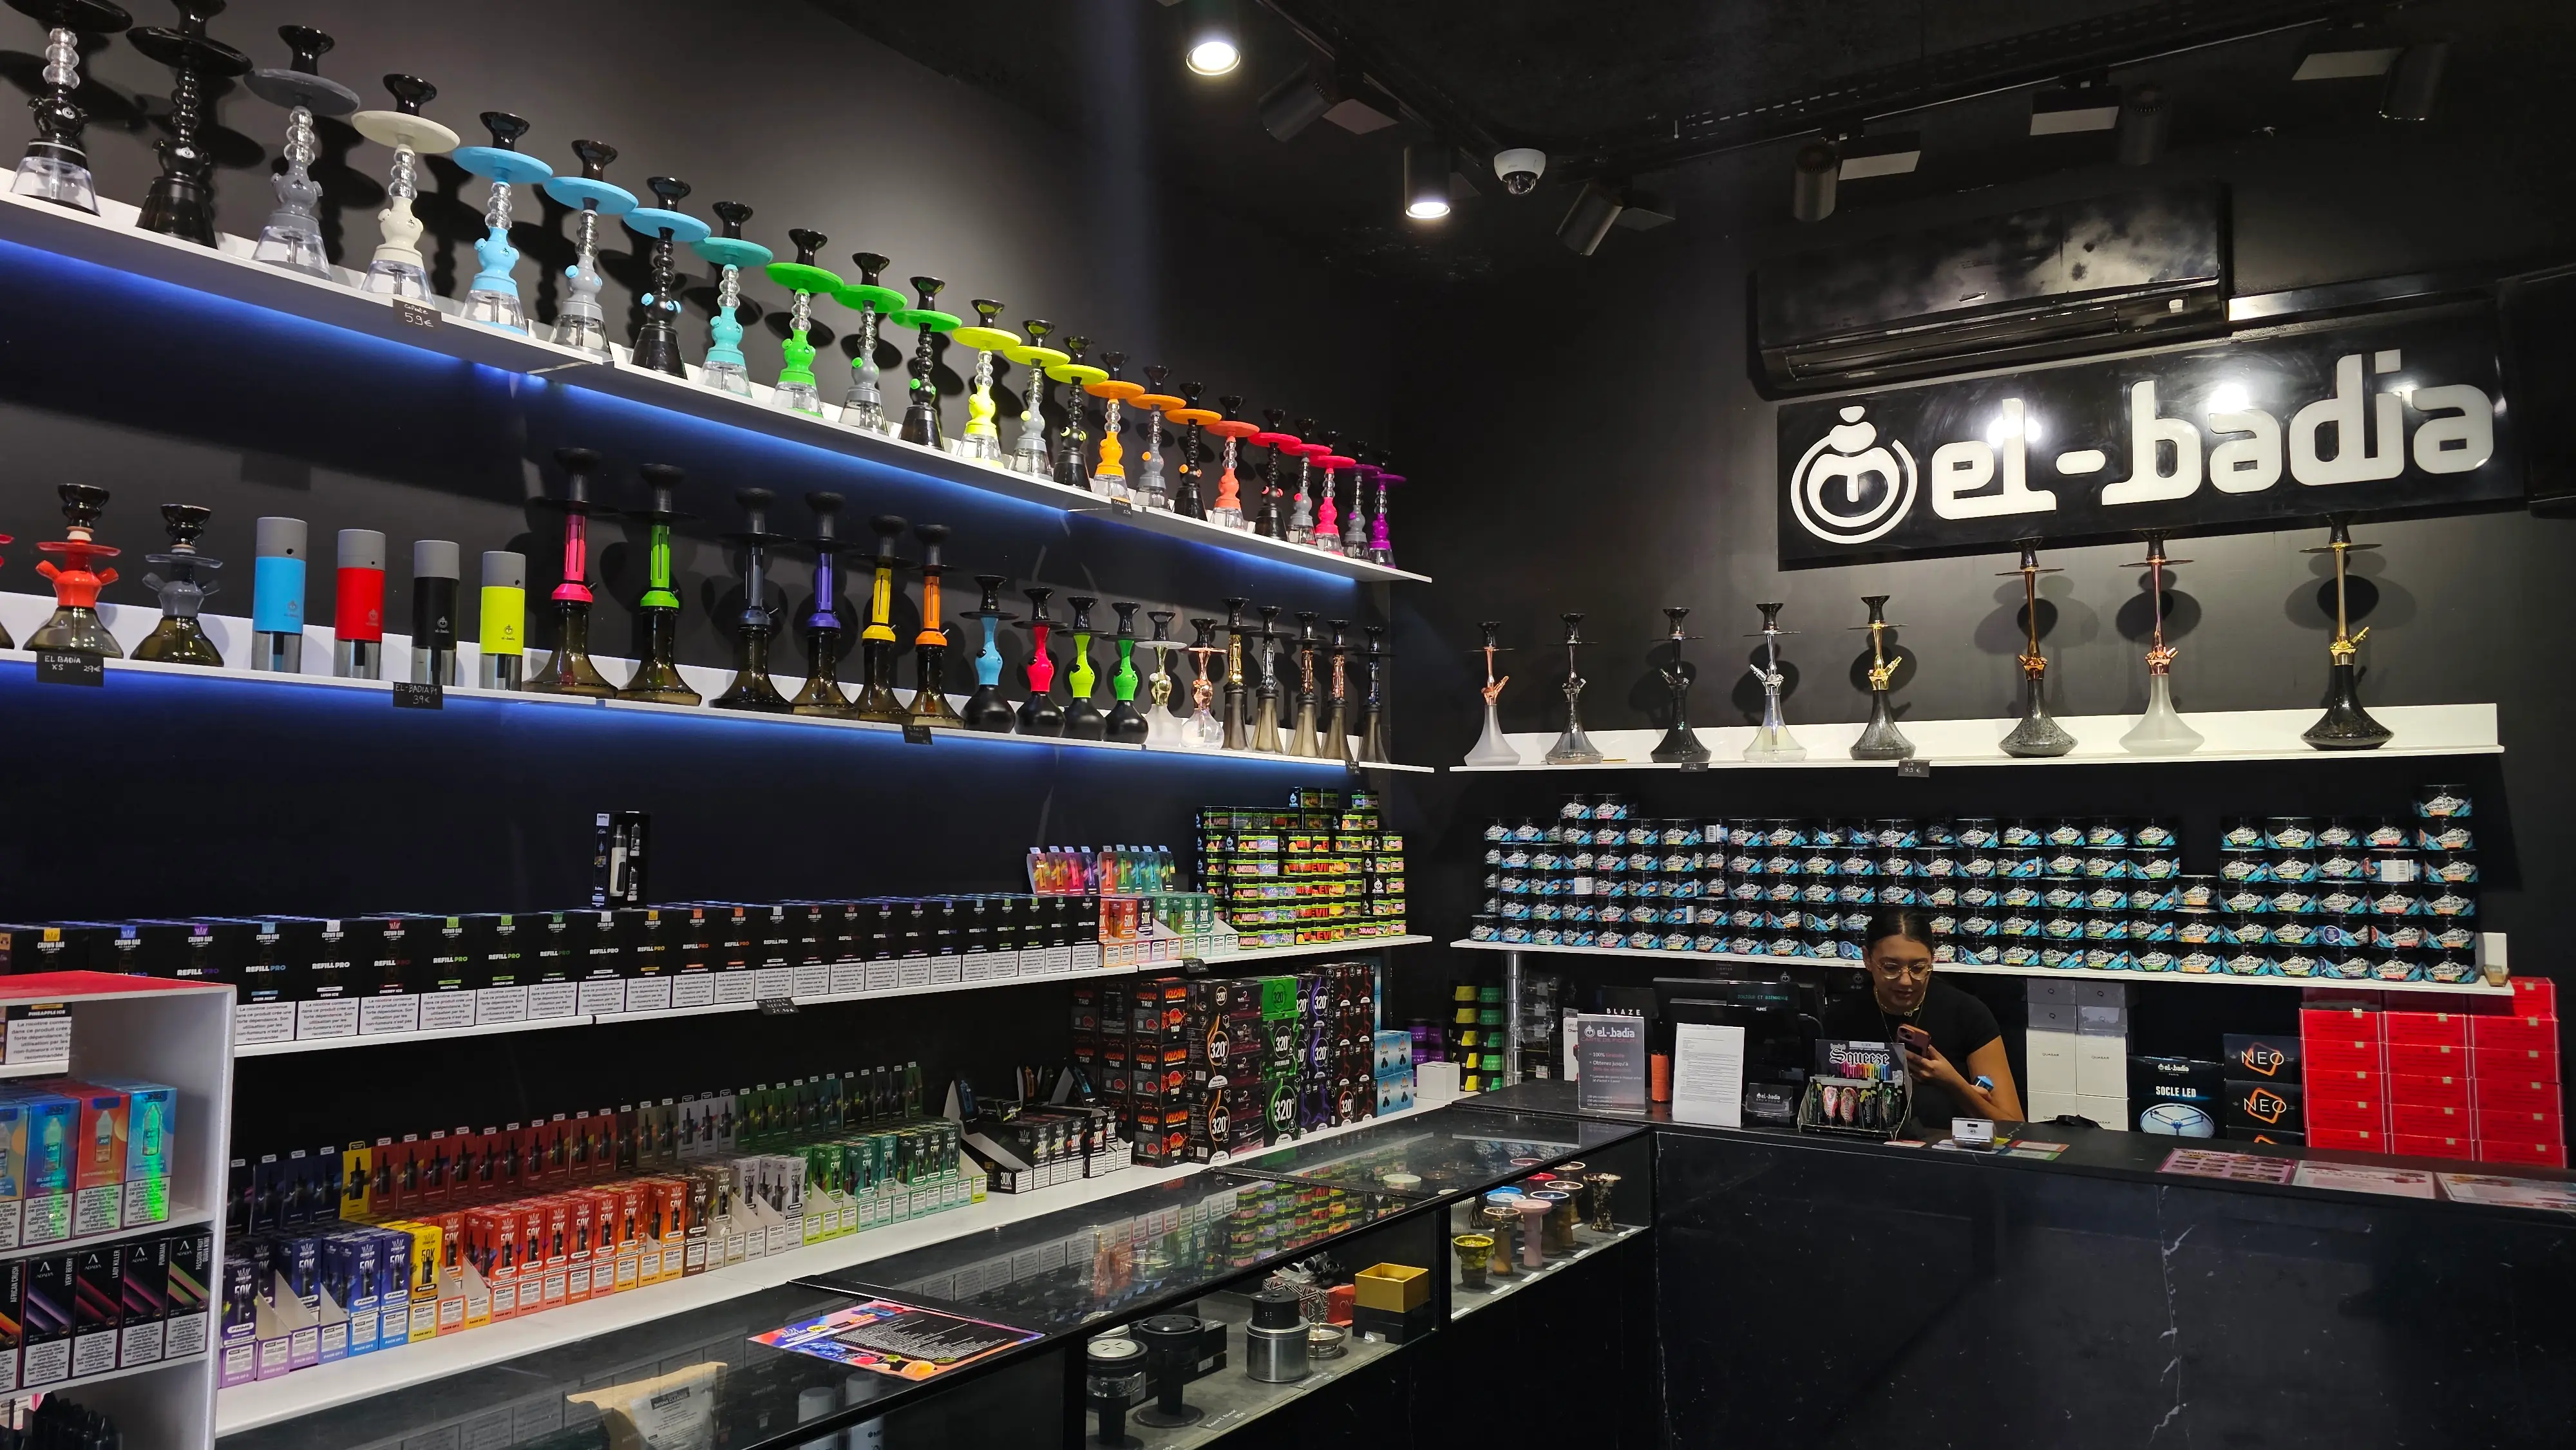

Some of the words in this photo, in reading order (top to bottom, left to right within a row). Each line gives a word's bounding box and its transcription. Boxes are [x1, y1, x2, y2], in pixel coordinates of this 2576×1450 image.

[404, 312, 433, 327] 59€
[1932, 350, 2494, 520] el-badia
[413, 695, 430, 704] 39€
[1166, 986, 1186, 999] VOLCANO
[1597, 1026, 1635, 1038] el-badia
[1164, 1049, 1186, 1061] VOLCANO
[1829, 1048, 1889, 1068] Squeeze
[2241, 1050, 2284, 1066] NEO
[2155, 1086, 2179, 1097] SOCLE
[2182, 1087, 2197, 1098] LED
[2244, 1098, 2287, 1113] NEO
[1166, 1110, 1188, 1124] VOLCANO
